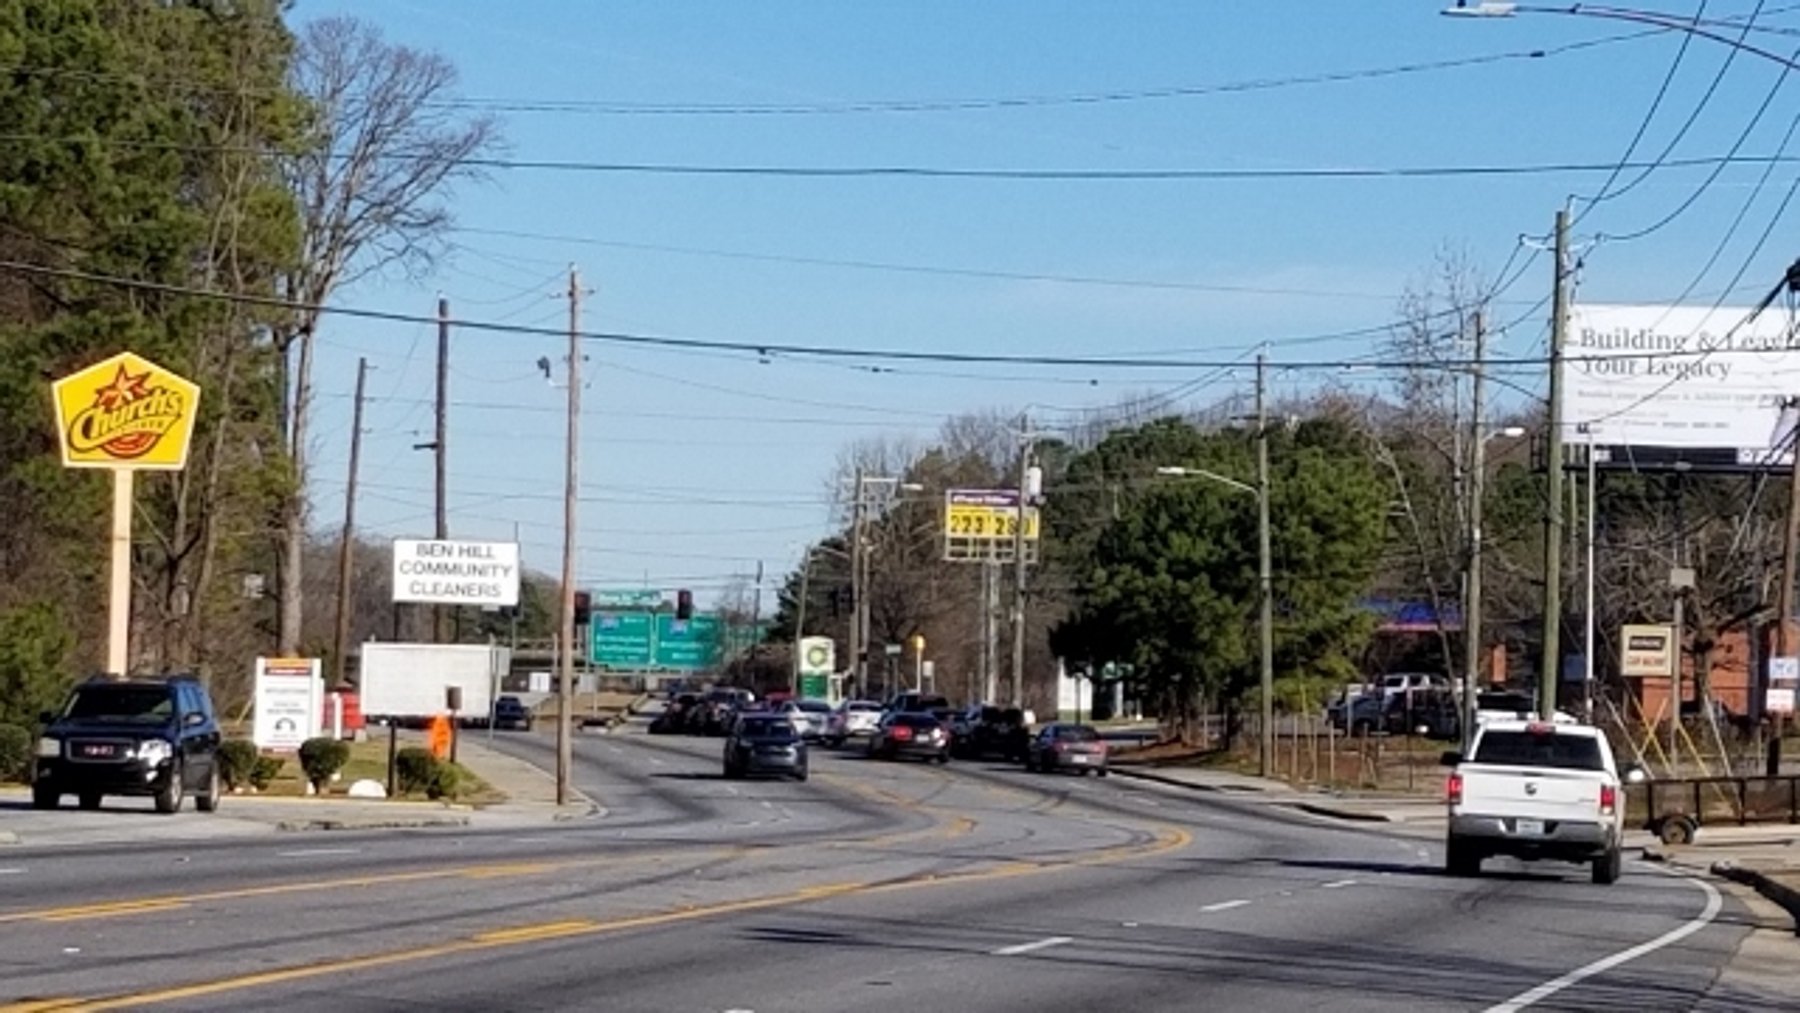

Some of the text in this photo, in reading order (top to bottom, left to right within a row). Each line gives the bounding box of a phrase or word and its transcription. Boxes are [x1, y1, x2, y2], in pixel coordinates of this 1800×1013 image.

[1580, 328, 1687, 355] Building
[1579, 354, 1732, 381] Your Legacy
[69, 387, 183, 453] Church's
[416, 543, 495, 560] BEN HILL
[399, 559, 513, 577] COMMUNITY
[408, 580, 502, 598] CLEANERS
